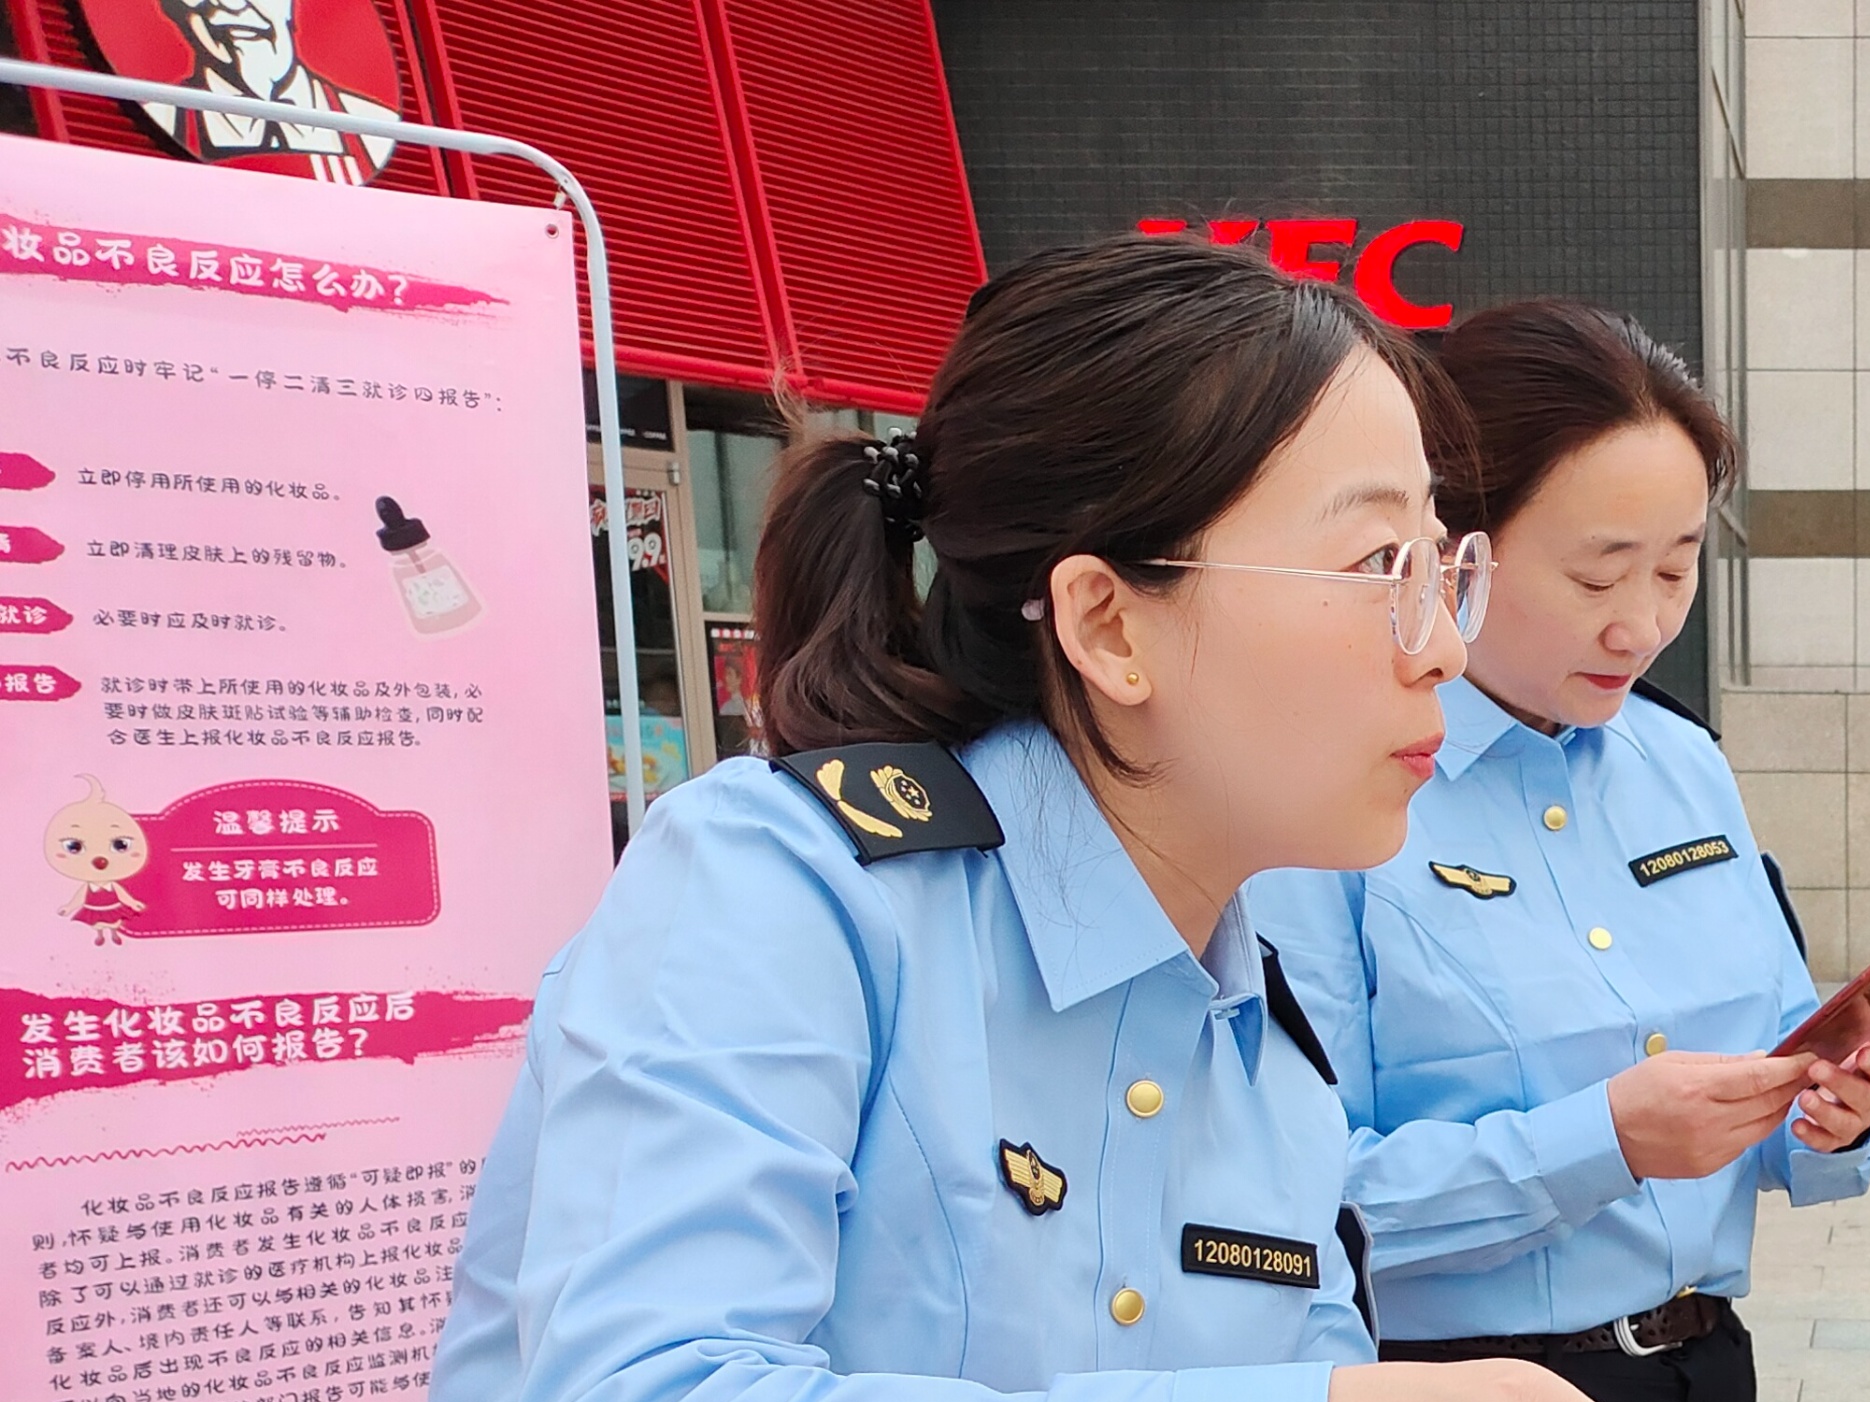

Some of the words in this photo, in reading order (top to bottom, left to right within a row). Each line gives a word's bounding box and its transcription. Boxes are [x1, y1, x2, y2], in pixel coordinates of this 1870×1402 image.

[1, 225, 408, 305] 妆品不良反应怎么办？
[1137, 219, 1464, 329] FC
[77, 467, 341, 501] 立即停用所使用的化妆品。
[86, 540, 347, 569] 立即清理皮肤上的残留物。
[92, 608, 287, 632] 必要时应及时就诊。
[0, 673, 57, 693] 报告
[101, 676, 483, 699] 就诊时带上所使用的化妆品及外包装，必
[104, 702, 484, 723] 要时做皮肤斑贴试验等辅助检查，同时配
[107, 729, 421, 748] 合医生上报化妆品不良反应报告。
[213, 809, 340, 836] 温馨提示
[182, 857, 379, 882] 发生牙膏不良反应
[1640, 840, 1729, 878] 12080128053
[216, 887, 350, 910] 可同样处理。
[20, 991, 416, 1044] 发生化妆品不良反应后
[21, 1027, 367, 1080] 消费者该如何报告？
[1194, 1238, 1312, 1277] 12080128091
[38, 1237, 463, 1308] 除了可以通过就诊的医疗机构上报化妆品
